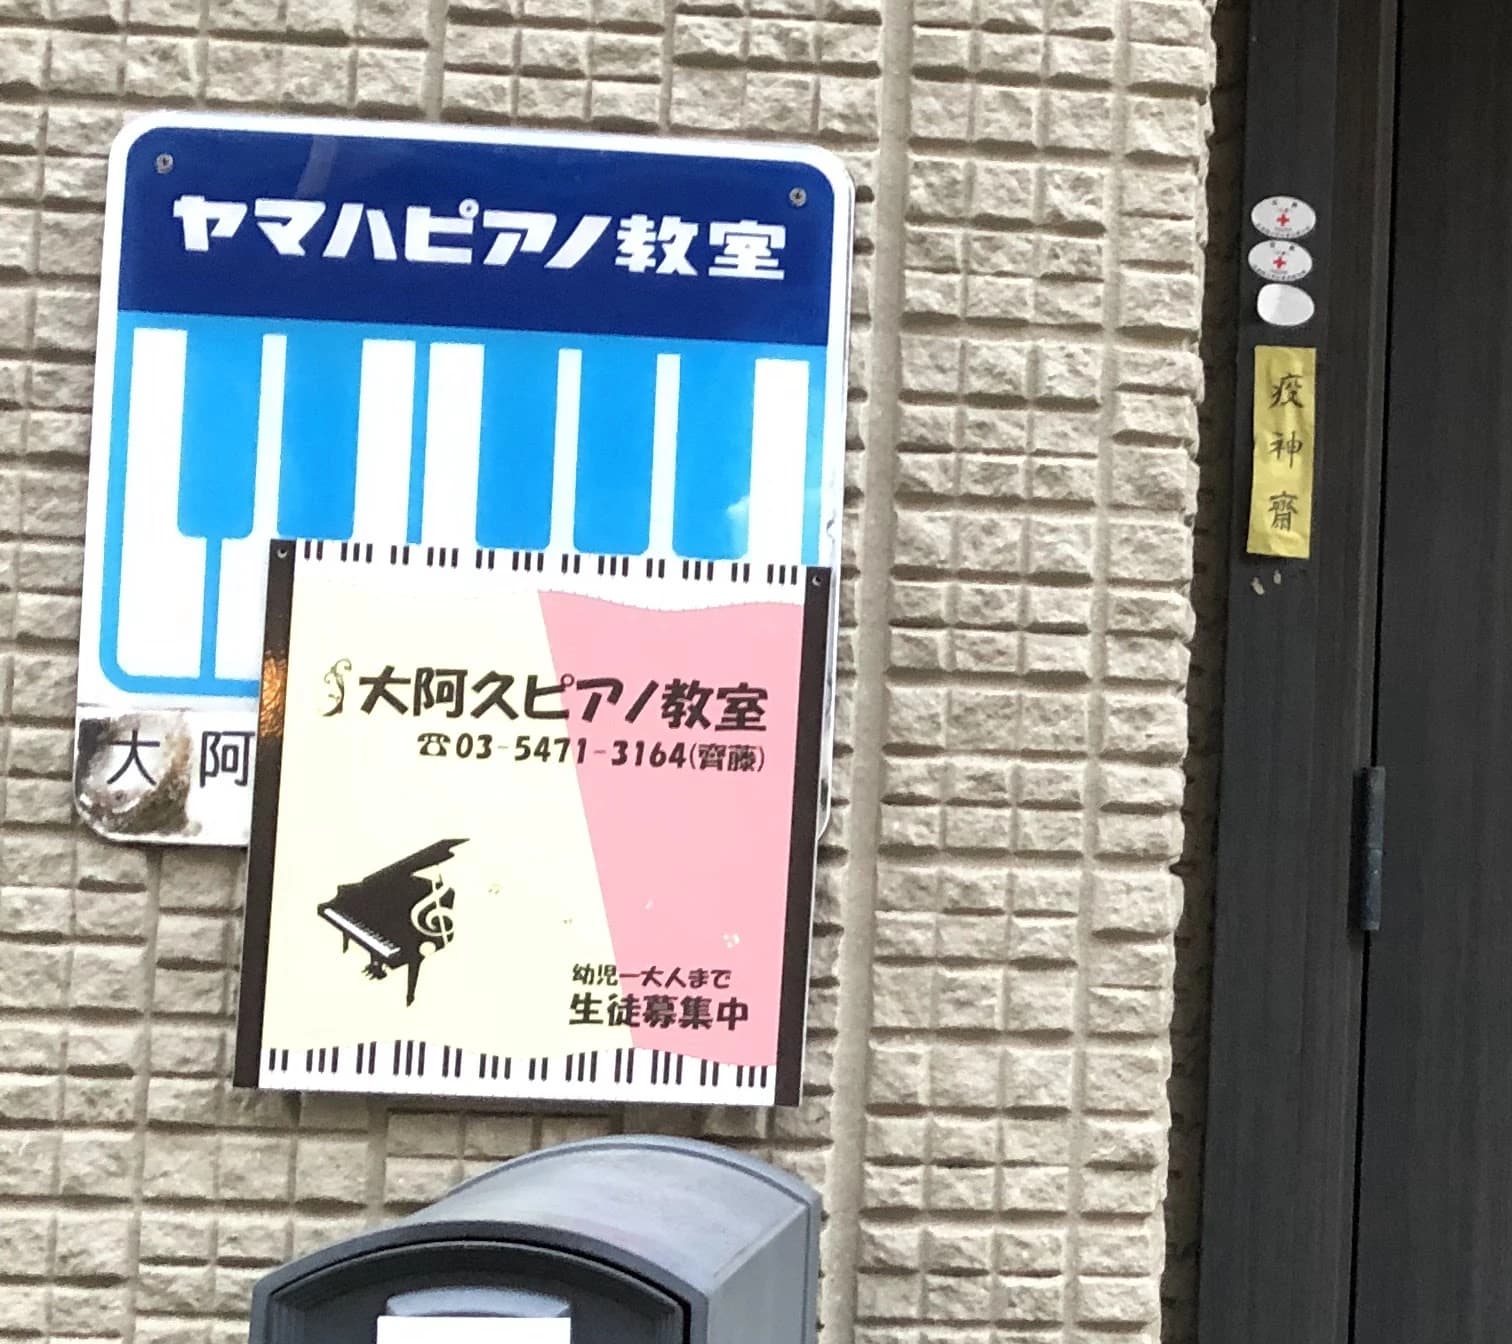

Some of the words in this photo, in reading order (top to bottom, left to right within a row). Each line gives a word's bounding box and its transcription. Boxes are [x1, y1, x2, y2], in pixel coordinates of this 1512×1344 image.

[173, 195, 785, 281] ヤマハピアノ教室
[358, 665, 768, 733] 大阿久ピアノ教室
[568, 992, 749, 1031] 生徒募集中
